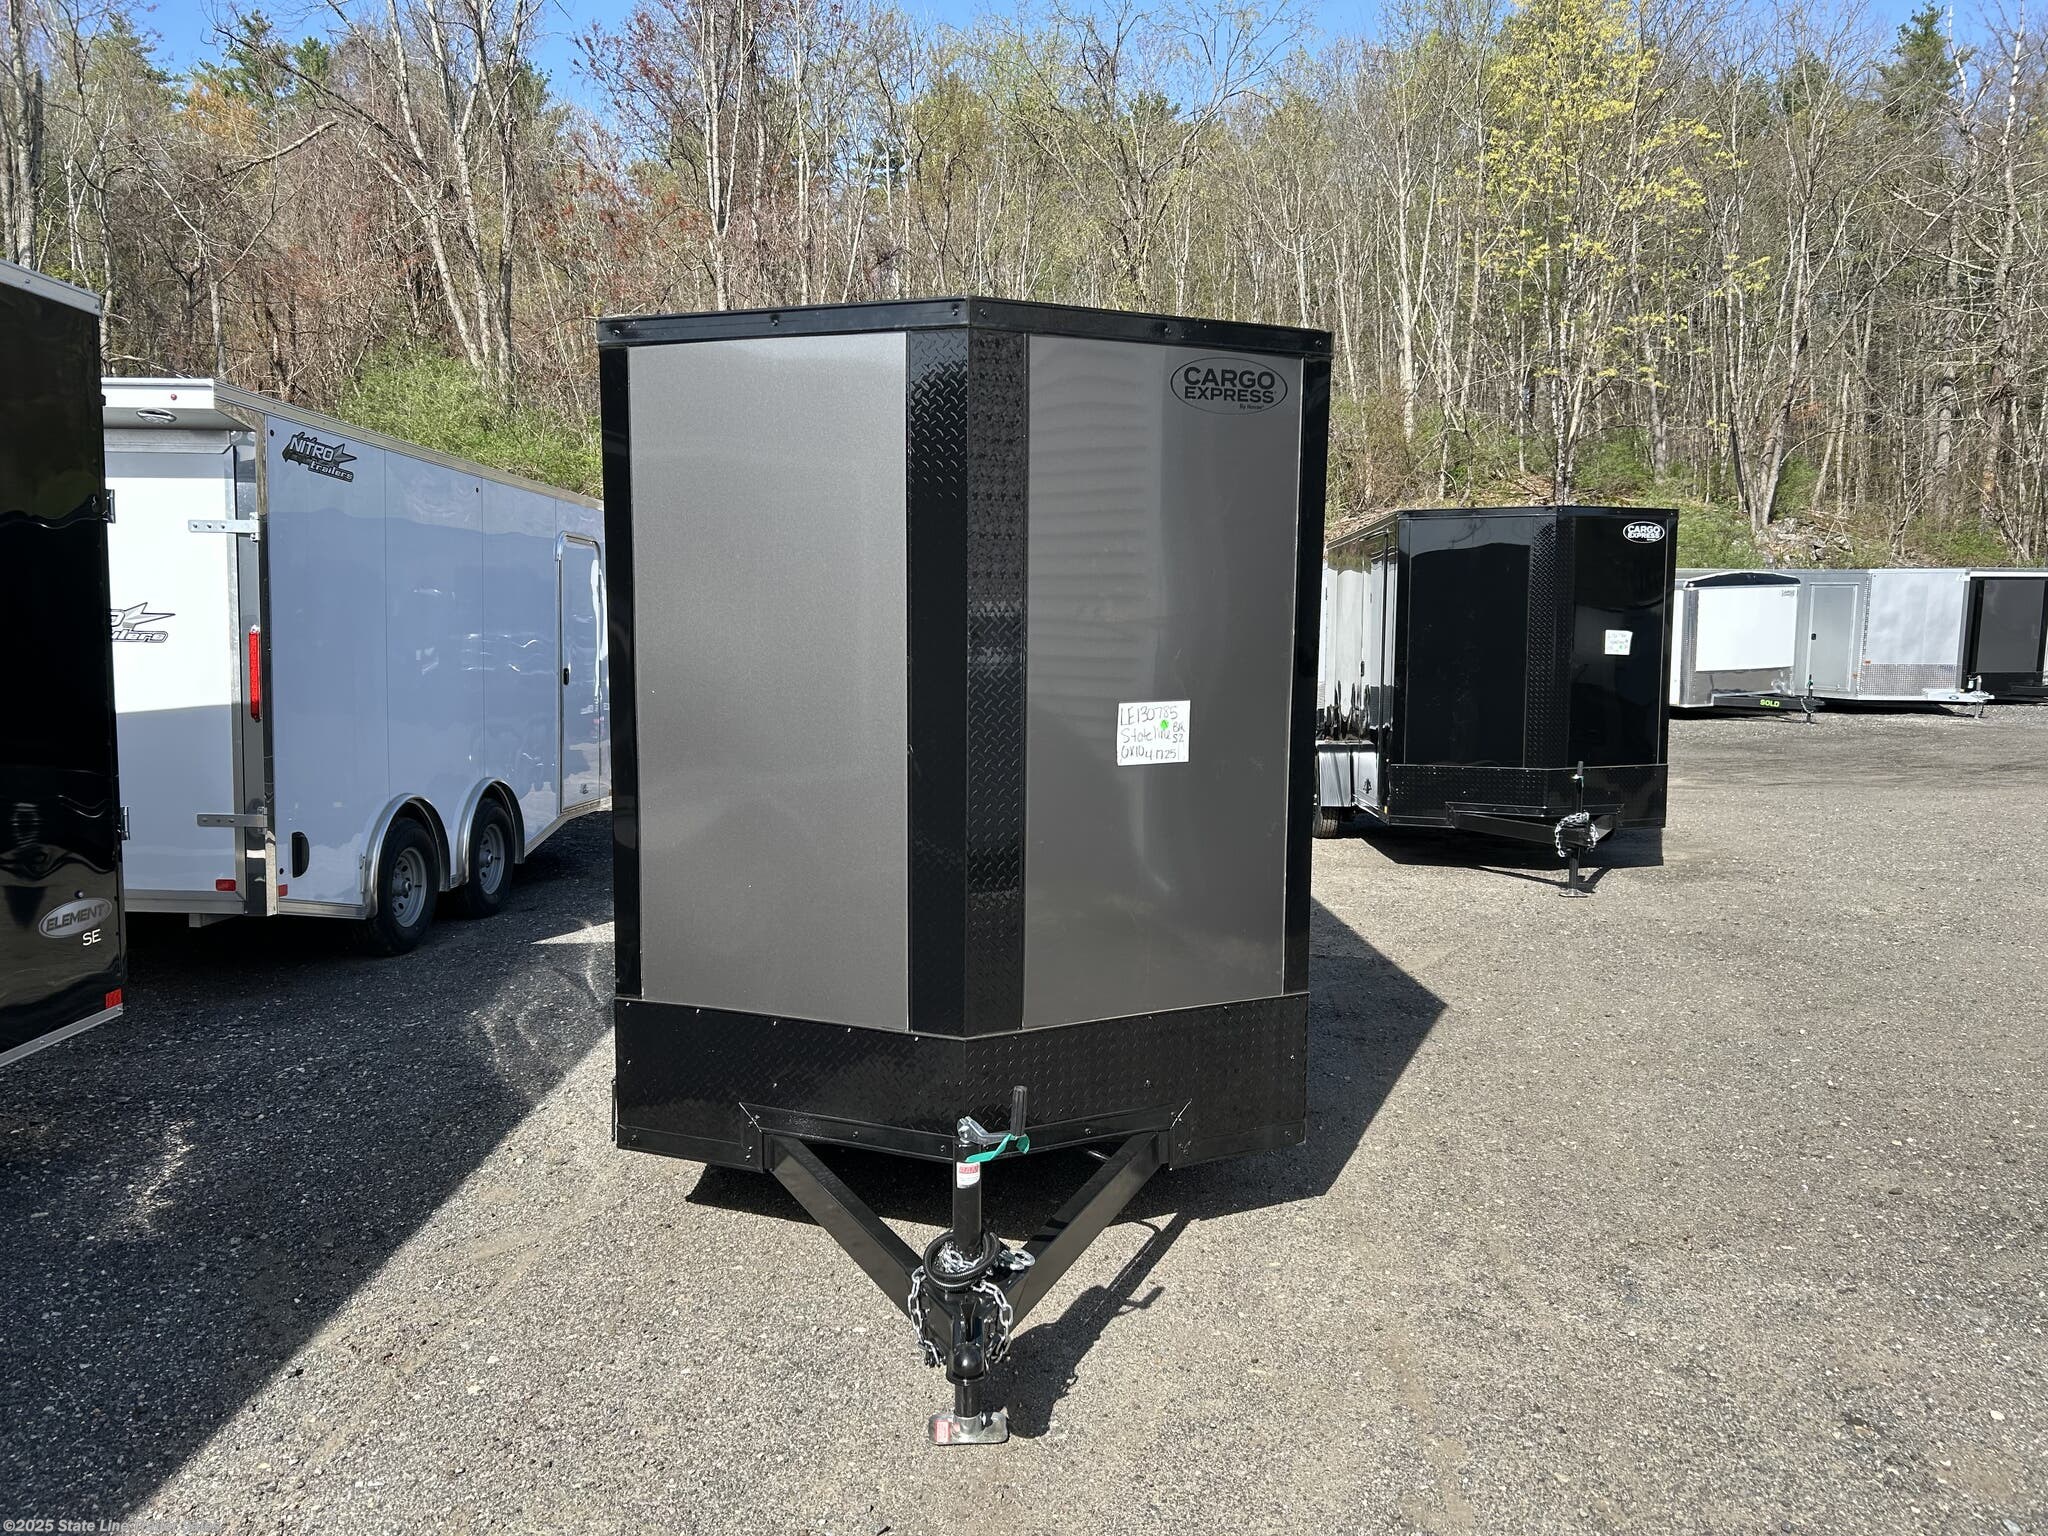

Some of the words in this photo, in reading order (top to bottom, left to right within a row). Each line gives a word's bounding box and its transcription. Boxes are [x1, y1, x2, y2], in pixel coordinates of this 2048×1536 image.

[1184, 366, 1276, 390] CARGO
[1184, 385, 1275, 404] EXPRESS
[289, 437, 335, 462] NITRO
[310, 460, 354, 480] trailers
[1627, 525, 1661, 534] CARGO
[1760, 699, 1780, 708] SOLD
[46, 903, 106, 931] ELEMENT
[82, 928, 102, 946] SE
